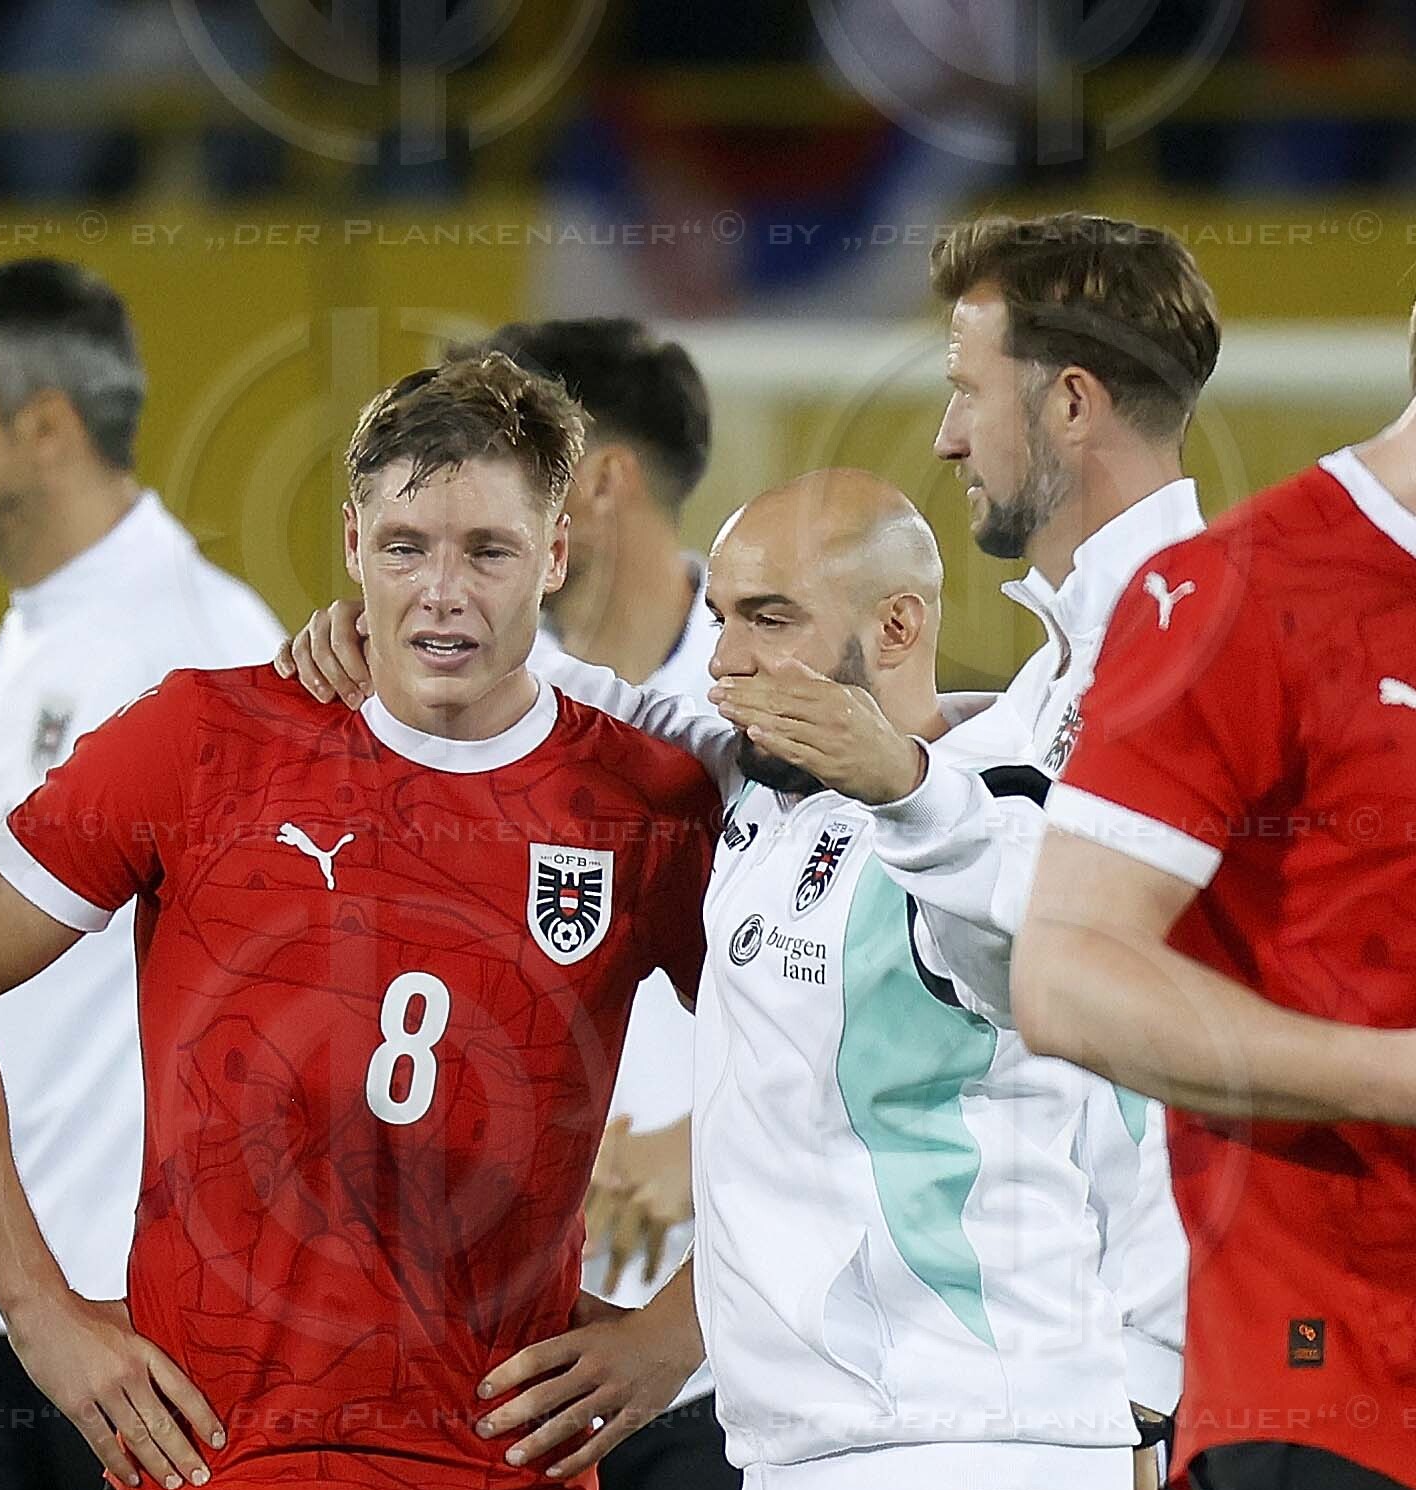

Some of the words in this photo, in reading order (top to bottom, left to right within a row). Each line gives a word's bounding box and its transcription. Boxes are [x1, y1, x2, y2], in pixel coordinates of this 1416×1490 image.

[766, 925, 827, 960] burgen
[783, 956, 826, 985] land
[365, 971, 452, 1125] 8
